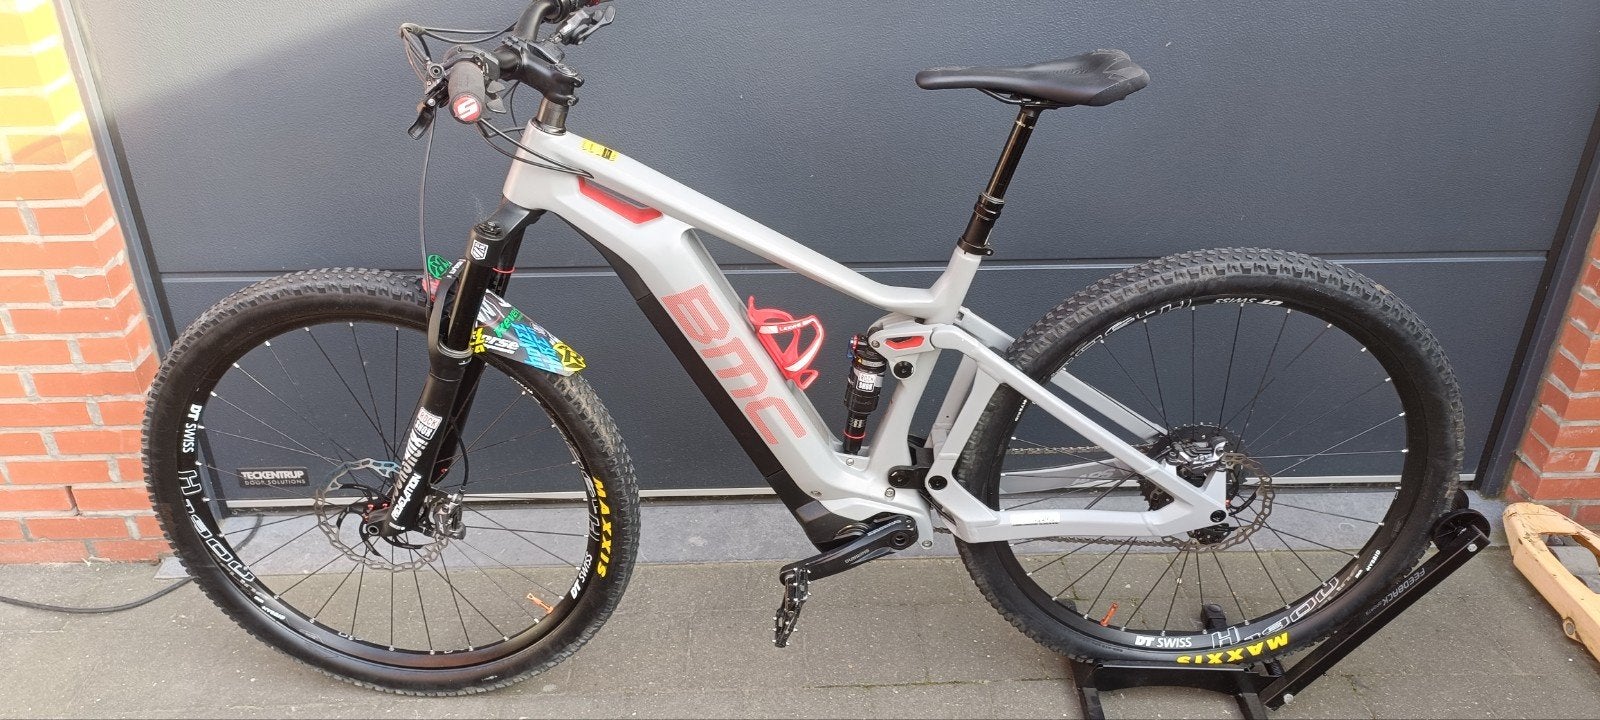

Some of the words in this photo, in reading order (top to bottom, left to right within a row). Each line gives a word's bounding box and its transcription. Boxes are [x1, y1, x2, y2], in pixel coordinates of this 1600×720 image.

[661, 283, 807, 445] BMC
[187, 403, 203, 422] DT
[182, 422, 198, 454] SWISS
[240, 470, 305, 480] TECKENTRUP
[593, 476, 612, 578] MAXXIS
[570, 580, 582, 600] DT
[578, 553, 593, 584] SWISS
[1365, 549, 1382, 573] HYBRID
[1382, 567, 1427, 606] FEEDBACK
[1135, 635, 1155, 647] DT
[1156, 637, 1192, 648] SWISS
[1177, 632, 1291, 666] MAXXIS
